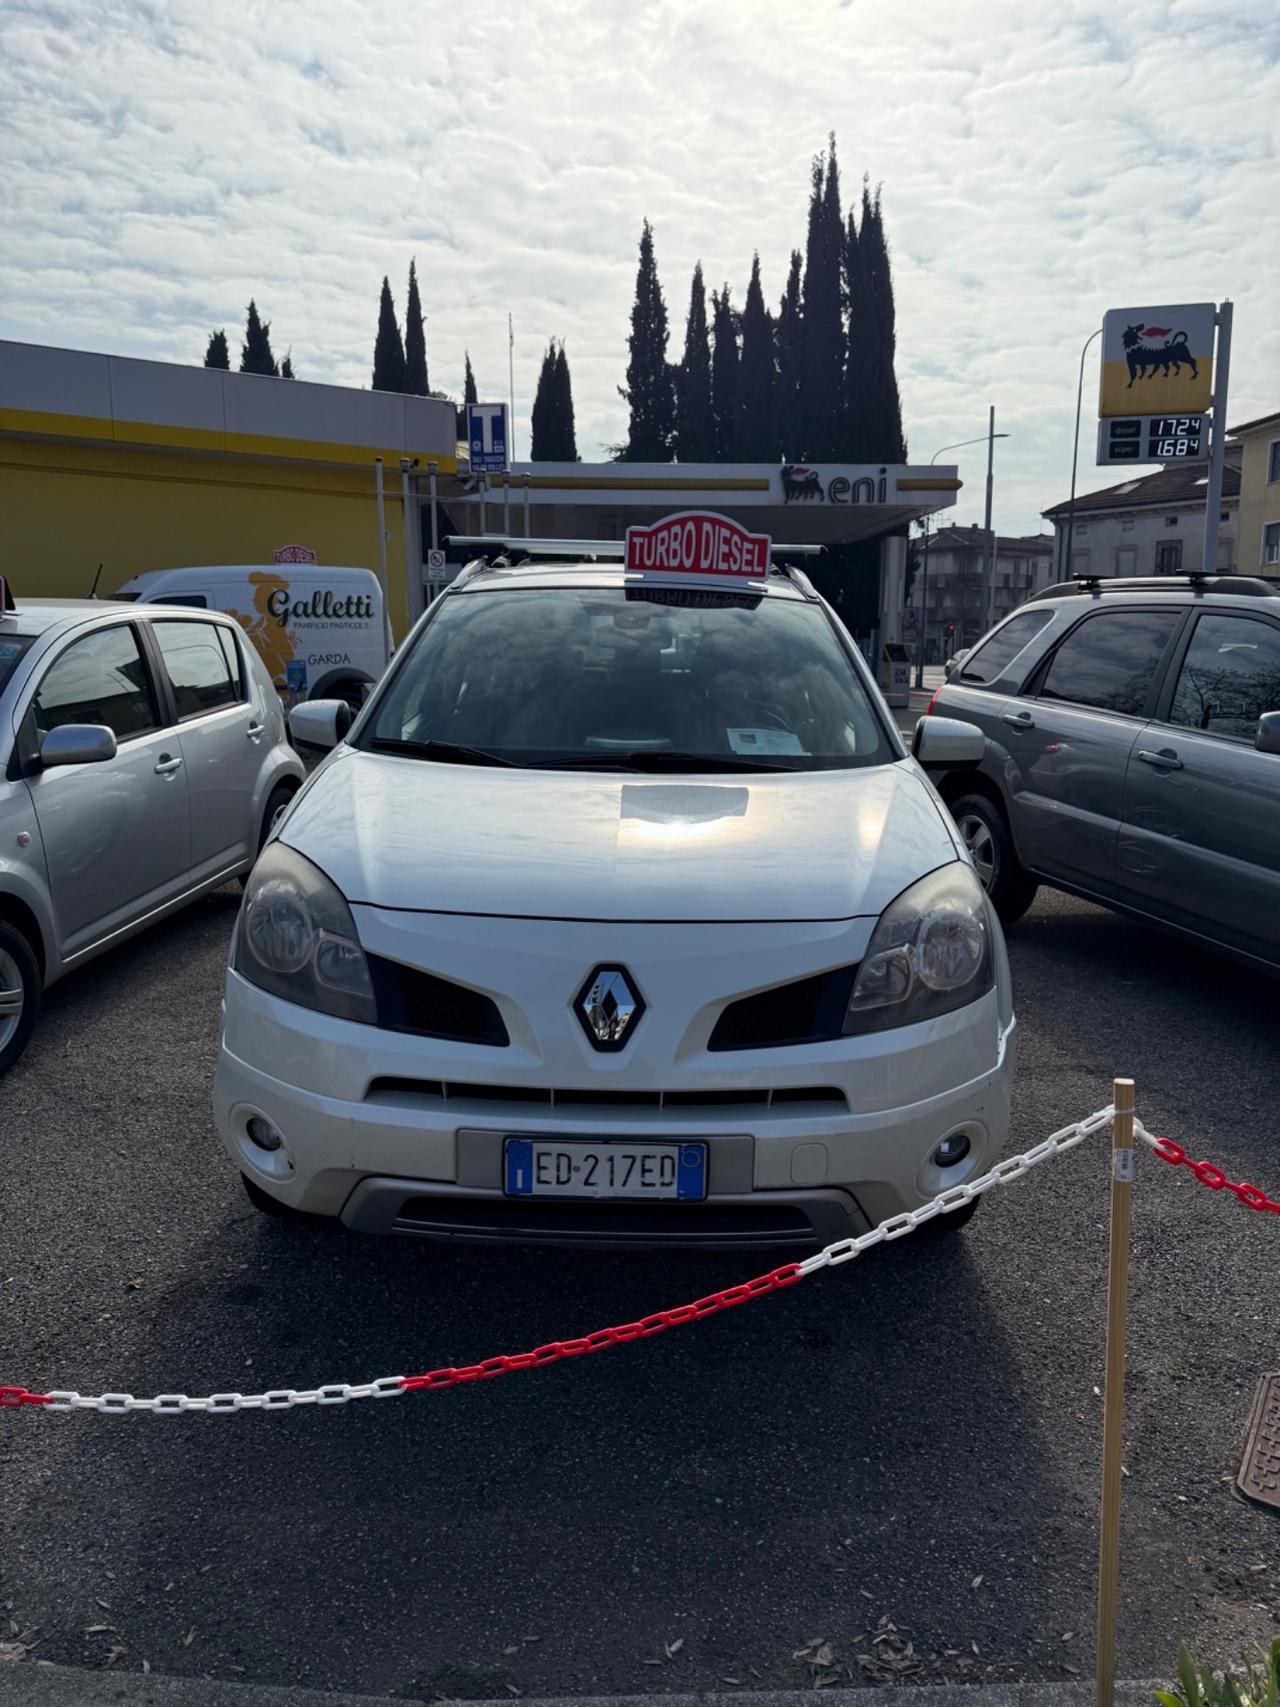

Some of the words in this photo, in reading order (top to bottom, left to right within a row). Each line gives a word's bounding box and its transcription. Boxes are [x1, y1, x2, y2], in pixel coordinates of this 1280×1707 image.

[472, 406, 502, 454] T
[1114, 424, 1136, 434] diesel
[1114, 446, 1134, 455] super
[829, 467, 887, 503] eni
[632, 520, 696, 568] TURBO
[700, 521, 763, 572] DIESEL
[267, 589, 374, 628] Galletti
[307, 653, 352, 665] GARDA
